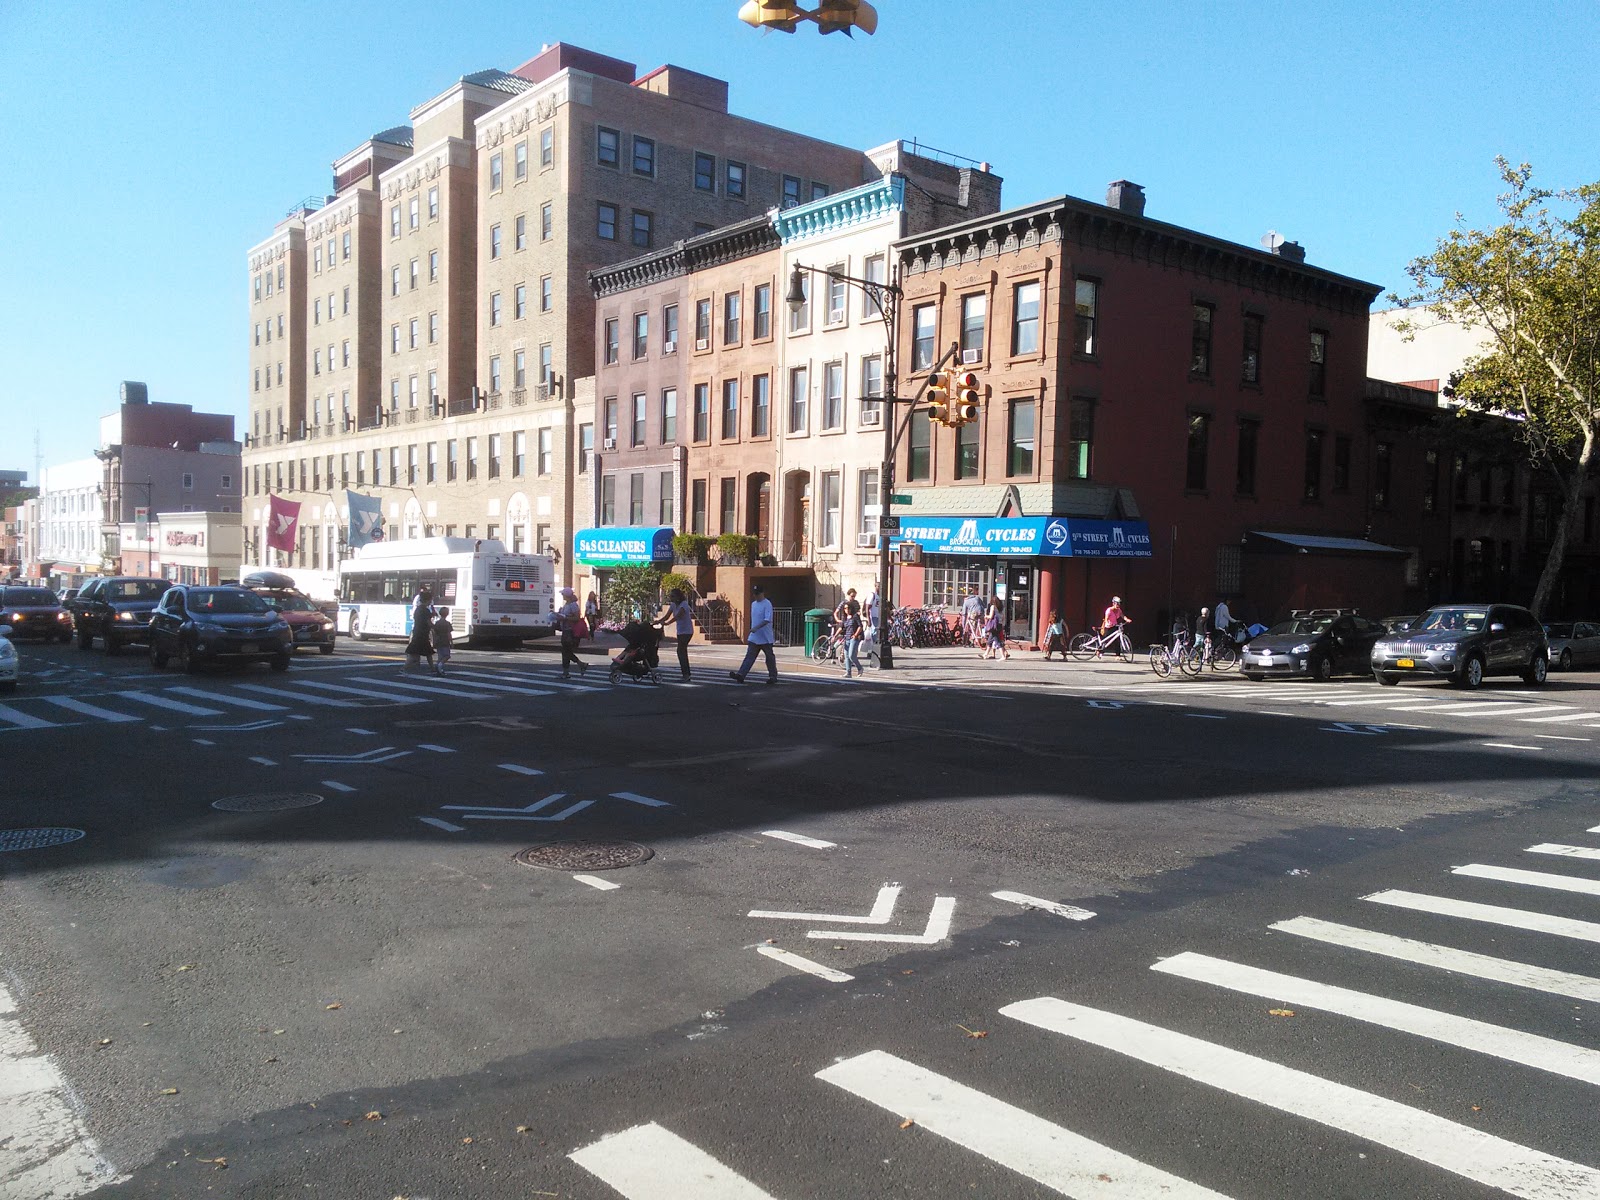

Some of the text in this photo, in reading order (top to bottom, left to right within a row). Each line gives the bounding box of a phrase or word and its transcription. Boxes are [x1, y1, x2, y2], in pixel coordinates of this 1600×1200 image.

[904, 527, 951, 540] STREET
[985, 528, 1036, 541] CYCLES
[1083, 533, 1109, 543] STREET
[1127, 534, 1150, 544] CYCLES
[580, 539, 646, 553] S&S CLEANERS
[949, 537, 983, 546] BROOKLYN
